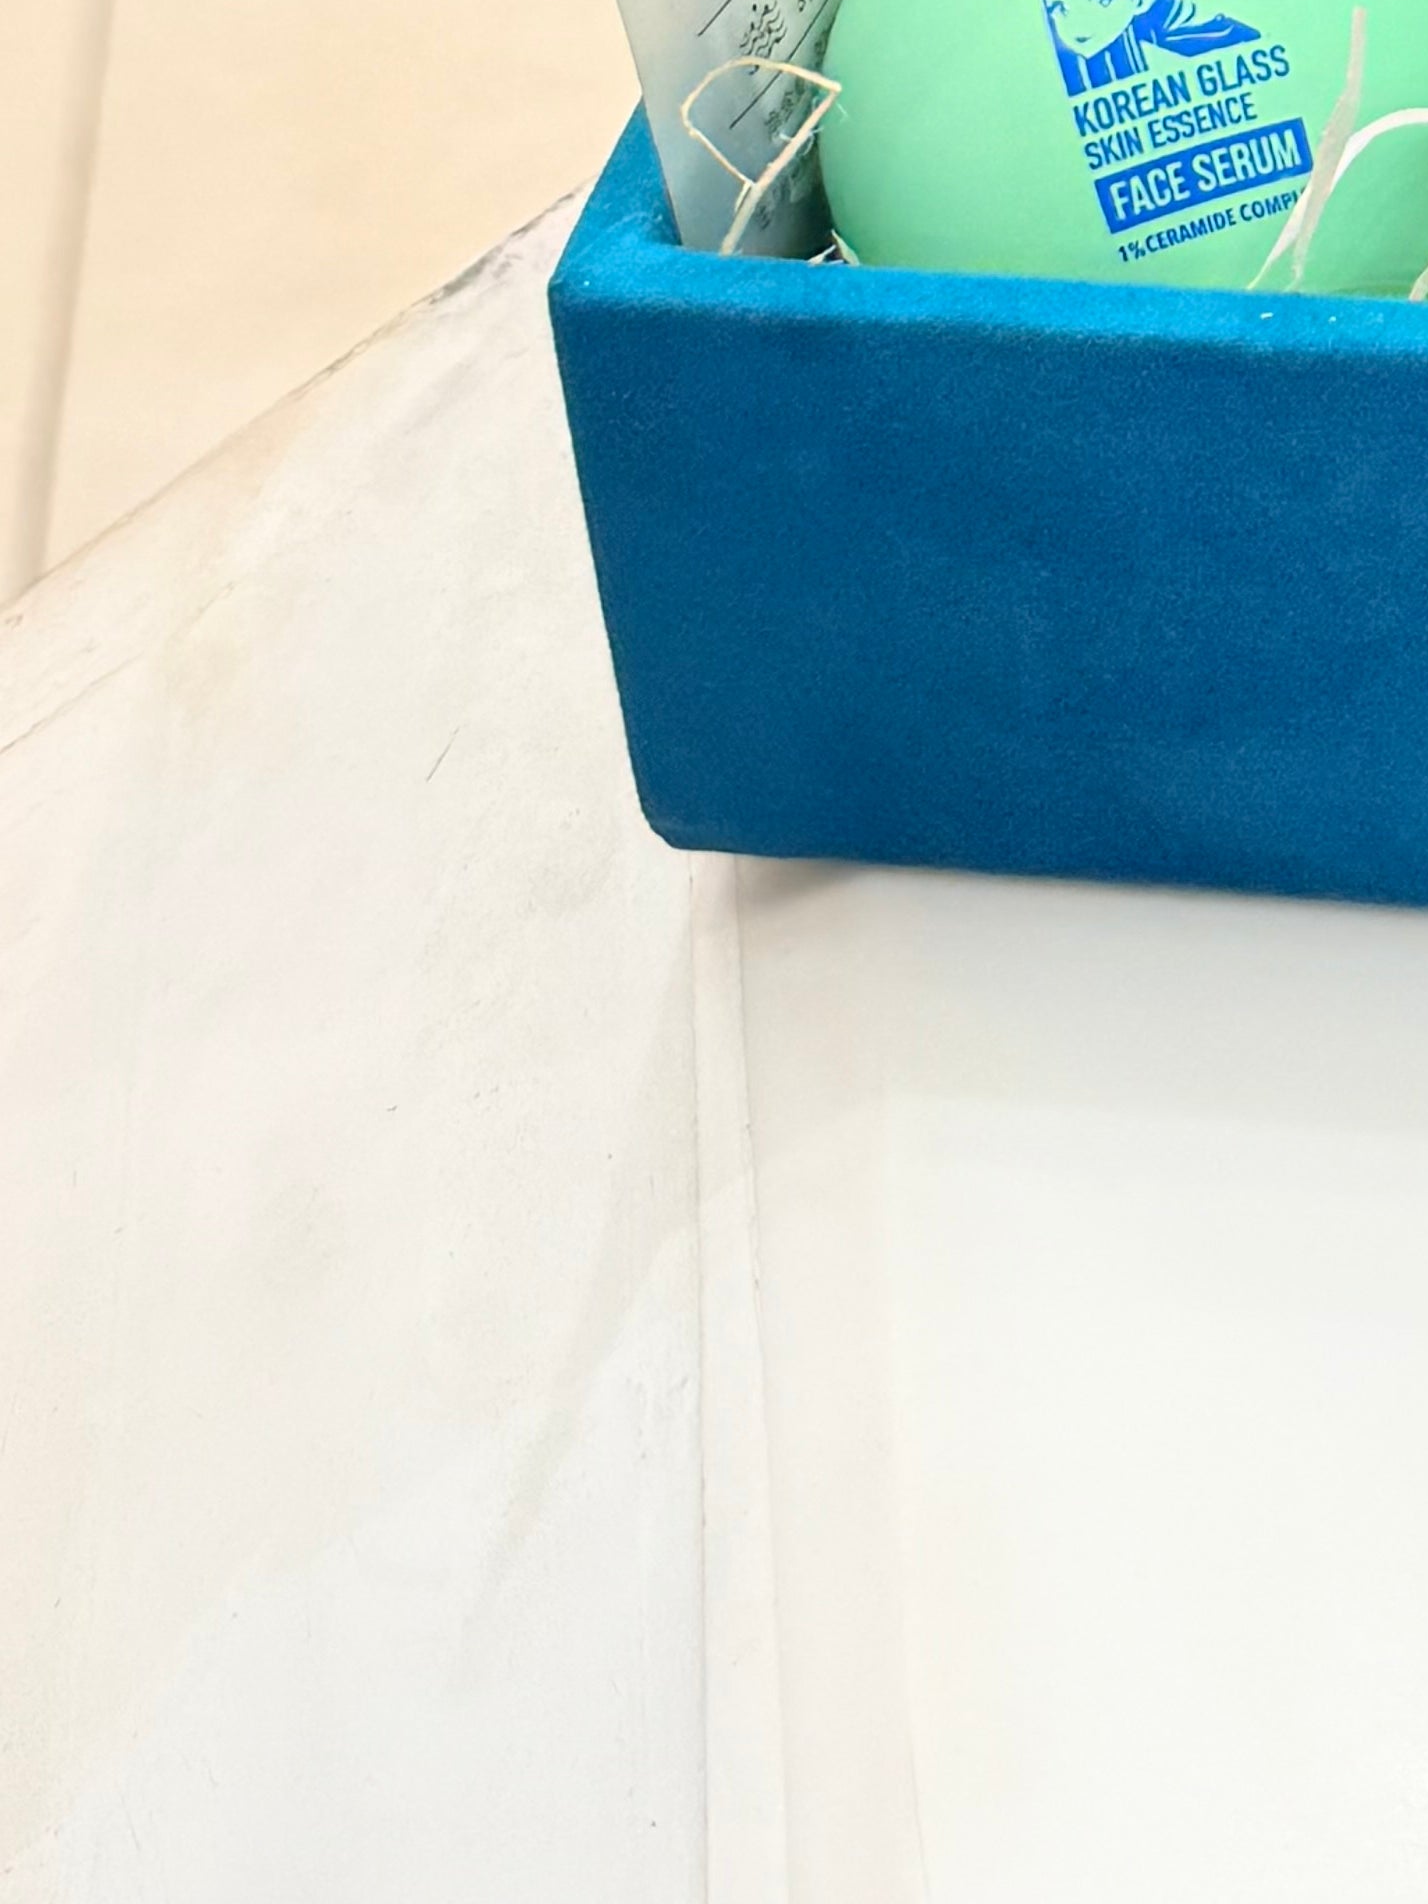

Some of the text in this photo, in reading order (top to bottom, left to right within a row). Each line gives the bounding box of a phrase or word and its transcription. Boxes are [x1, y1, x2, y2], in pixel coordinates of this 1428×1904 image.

[1073, 45, 1290, 136] KOREAN GLASS
[1085, 92, 1258, 170] SKIN ESSENCE
[1109, 128, 1302, 222] FACE SERUM
[1145, 208, 1238, 254] CERAMIDE
